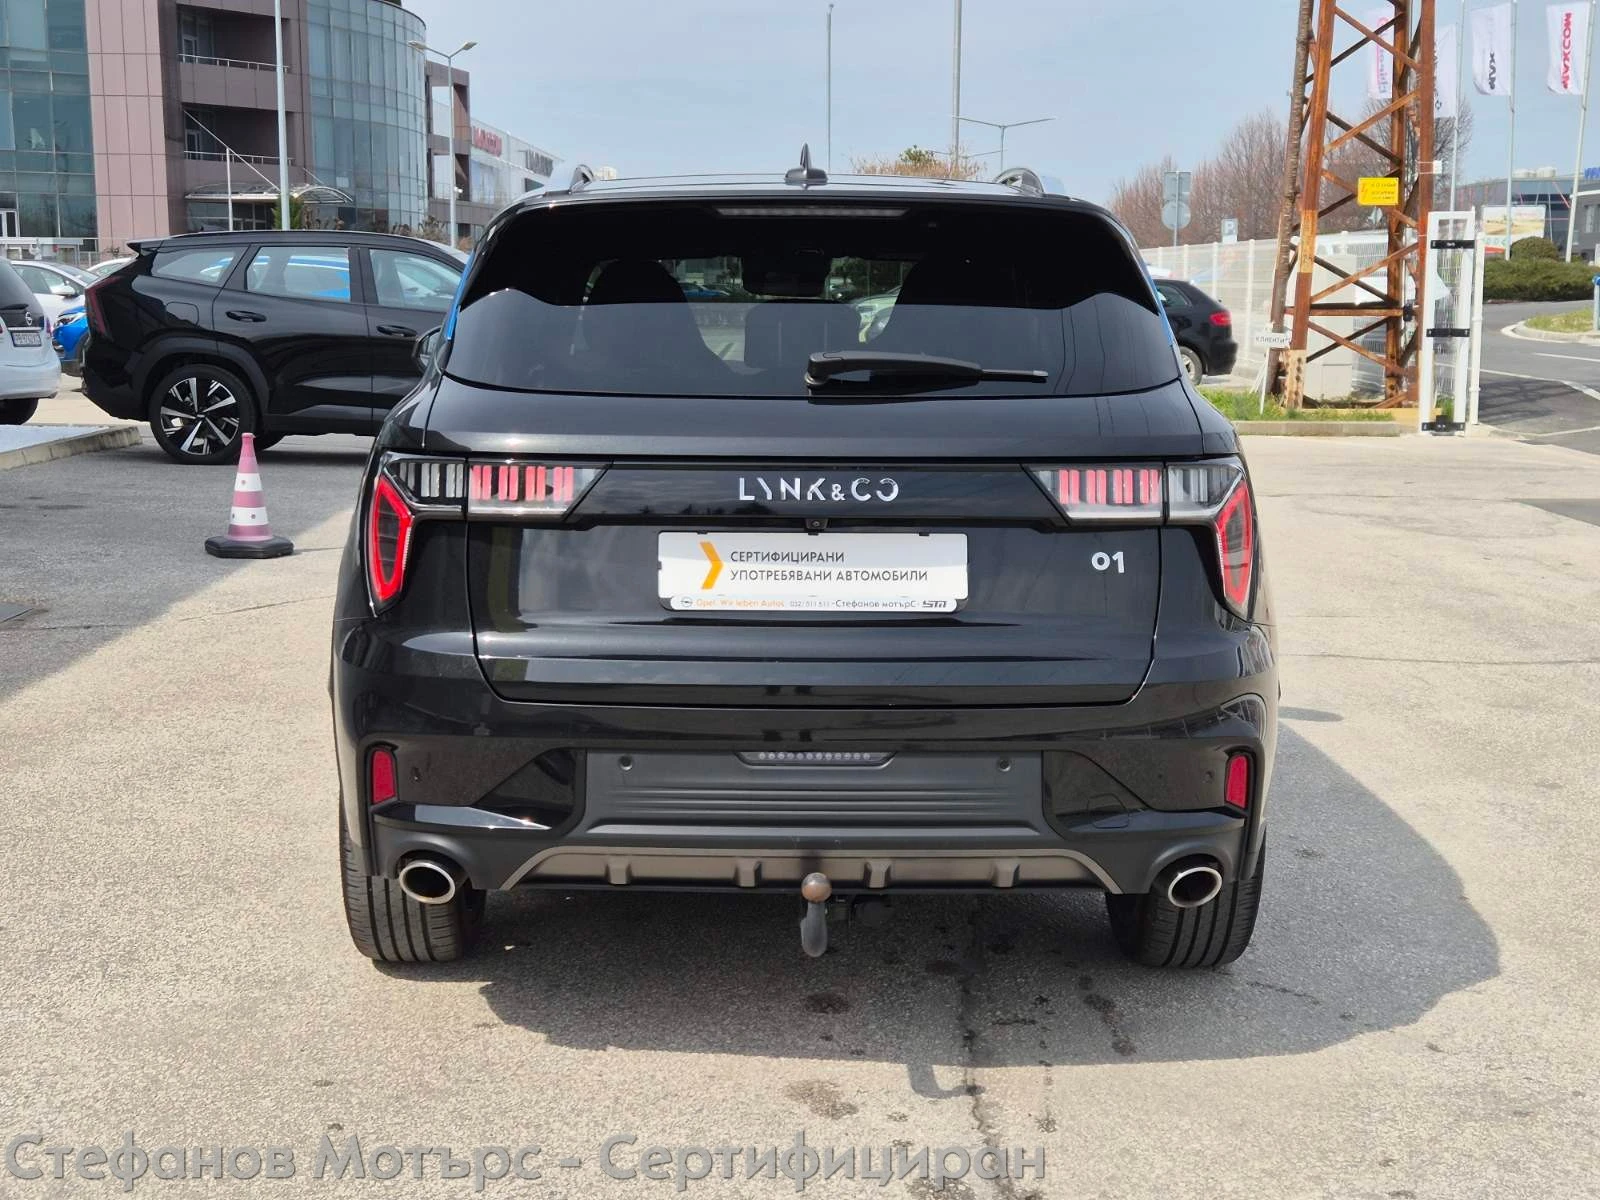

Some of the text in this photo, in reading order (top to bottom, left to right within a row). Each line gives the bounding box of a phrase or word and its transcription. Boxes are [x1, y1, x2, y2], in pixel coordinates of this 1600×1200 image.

[730, 551, 845, 564] СЕРТИФИЦИРАНИ
[1091, 551, 1125, 574] 01
[730, 570, 928, 581] УПОТРЕБЯВАНИ АВТОМОБИЛИ
